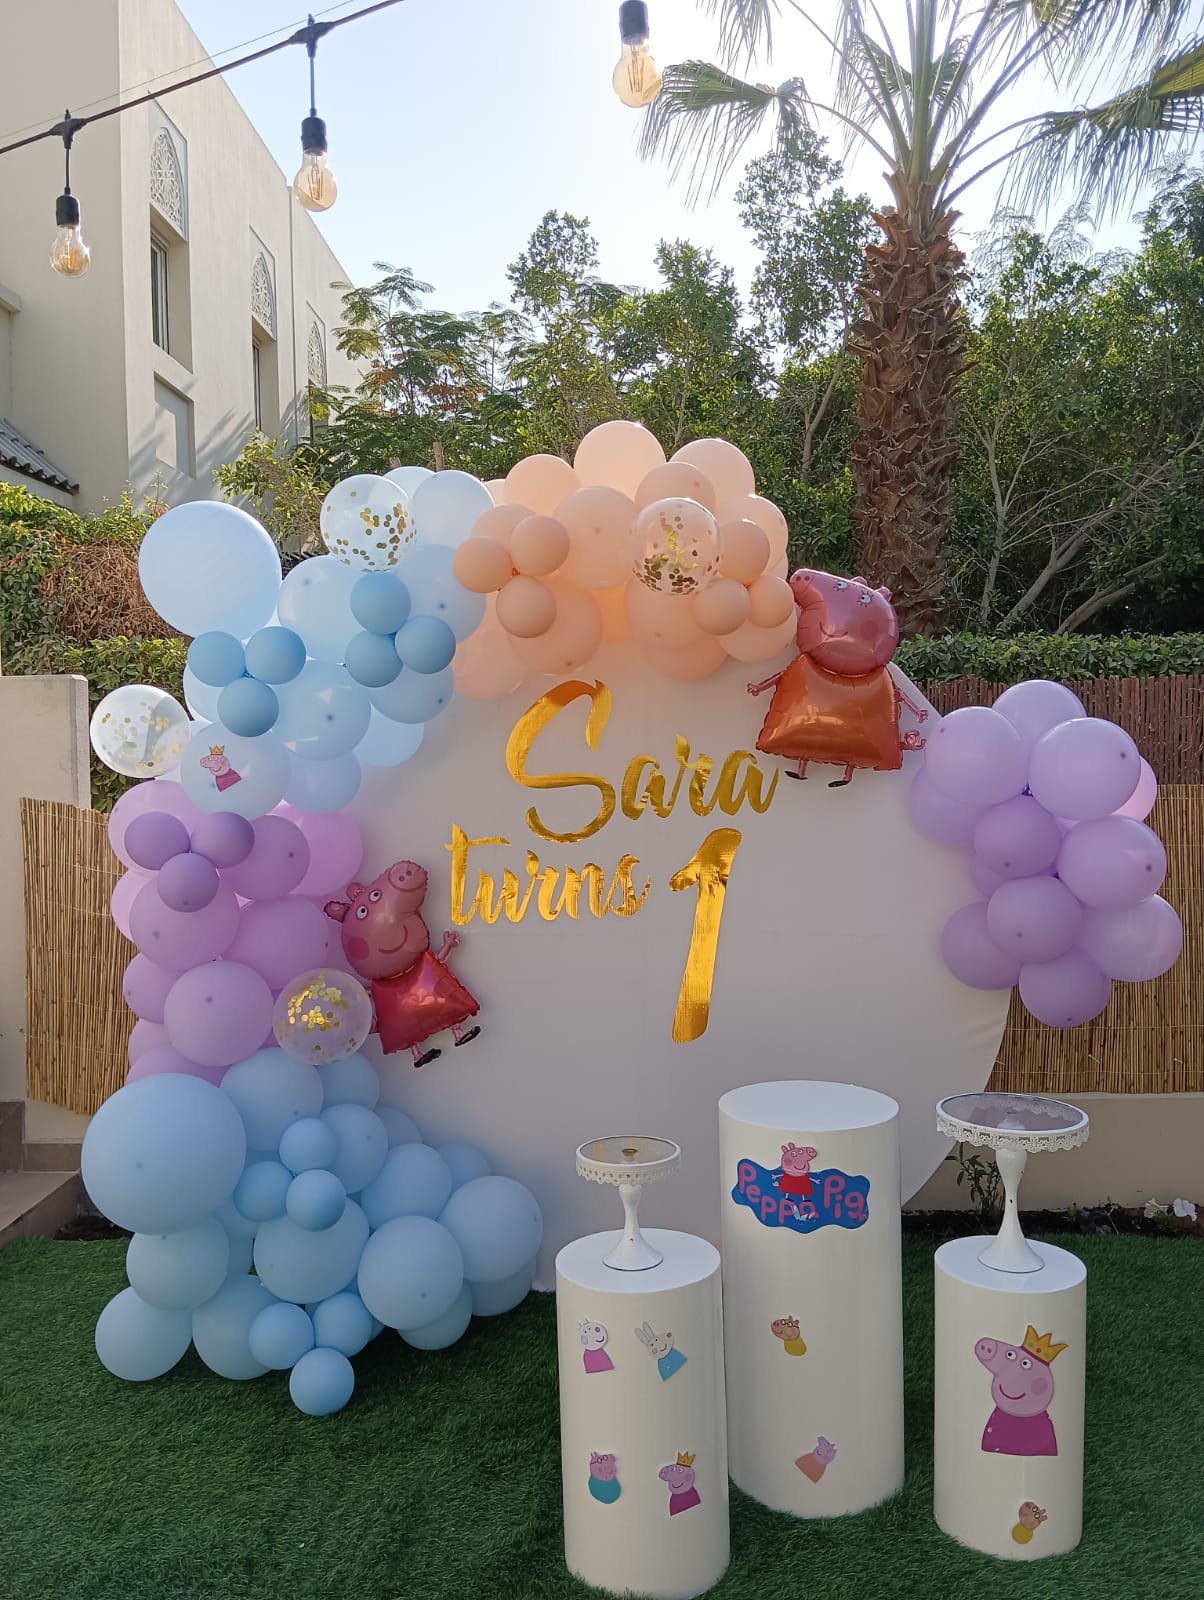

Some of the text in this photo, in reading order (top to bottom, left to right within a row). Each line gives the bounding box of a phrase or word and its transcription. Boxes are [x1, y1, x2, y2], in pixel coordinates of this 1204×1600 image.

[505, 679, 779, 843] Sara
[444, 823, 742, 1044] turns 1
[738, 1162, 866, 1225] Peppa Pig
